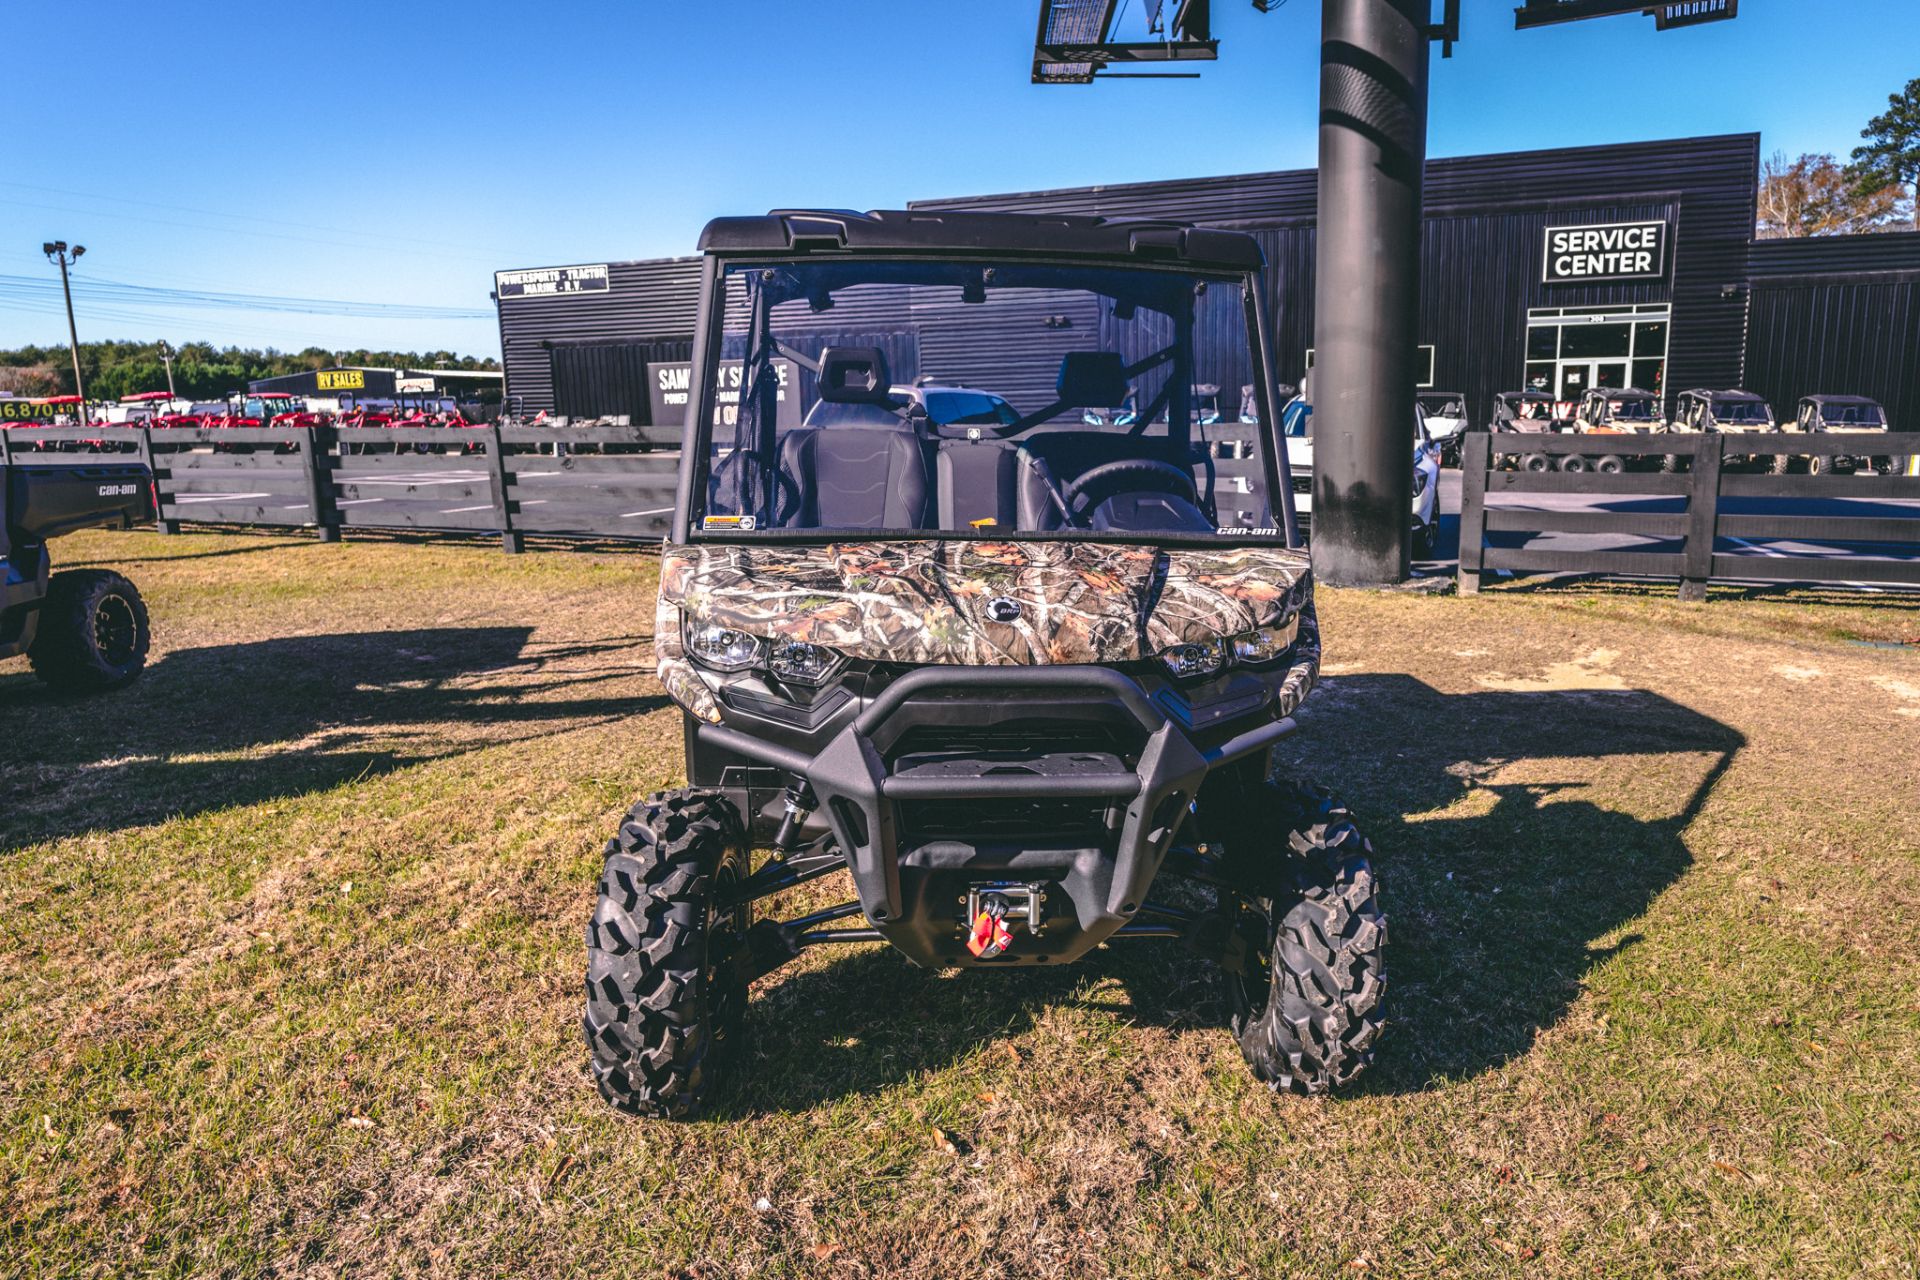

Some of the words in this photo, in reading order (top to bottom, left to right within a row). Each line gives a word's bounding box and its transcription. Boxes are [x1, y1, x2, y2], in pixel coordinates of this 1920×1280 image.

[1553, 227, 1657, 253] SERVICE
[1555, 251, 1651, 276] CENTER
[500, 271, 560, 285] POWERSPORTS
[567, 267, 606, 280] TRACTOR
[523, 282, 558, 294] MARINE
[319, 374, 331, 388] RV
[333, 373, 362, 387] SALES
[659, 367, 691, 390] SAM
[99, 484, 137, 496] can-am
[1216, 527, 1278, 536] can-am
